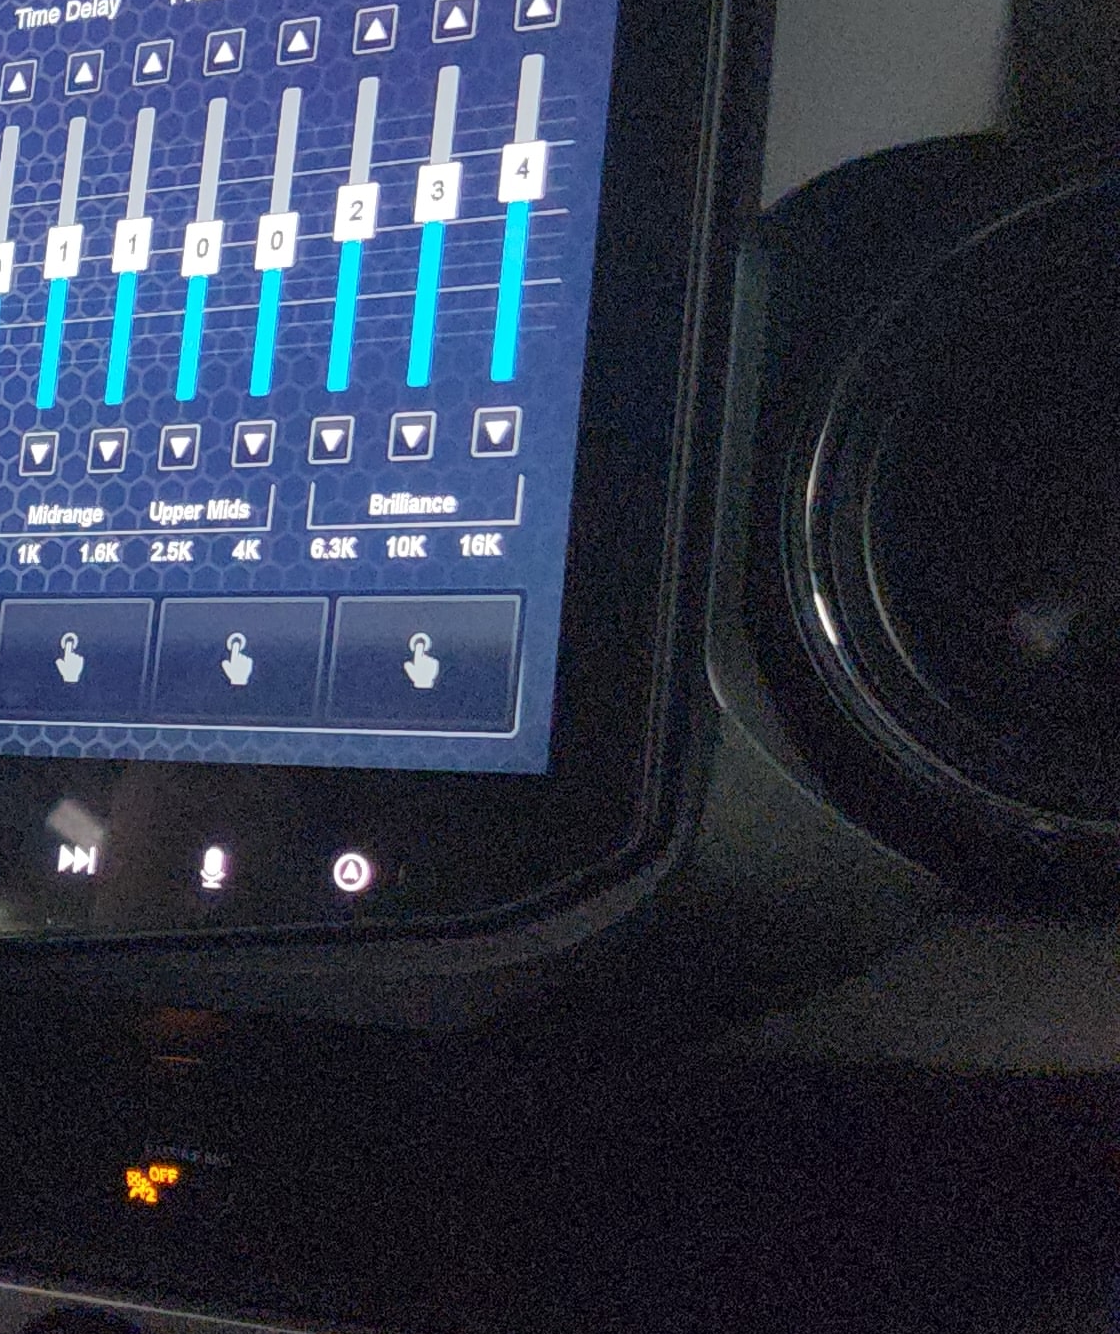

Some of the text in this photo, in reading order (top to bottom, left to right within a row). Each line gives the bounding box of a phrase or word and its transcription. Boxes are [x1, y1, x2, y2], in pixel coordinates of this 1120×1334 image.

[14, 7, 60, 30] Time
[515, 157, 530, 180] 4
[431, 178, 445, 202] 3
[349, 199, 364, 222] 2
[59, 240, 69, 262] 1
[128, 233, 137, 255] 1
[196, 237, 210, 258] 0
[270, 230, 284, 251] 0
[28, 504, 104, 528] Midrange
[149, 499, 251, 525] Upper Mids
[368, 492, 457, 517] Brilliance
[17, 544, 42, 565] 1K
[79, 542, 119, 563] 1.6K
[150, 540, 194, 562] 2.5K
[232, 539, 262, 560] 4K
[310, 537, 358, 560] 6.3K
[386, 535, 427, 558] 10K
[460, 533, 503, 557] 16K
[148, 1165, 180, 1184] OFF
